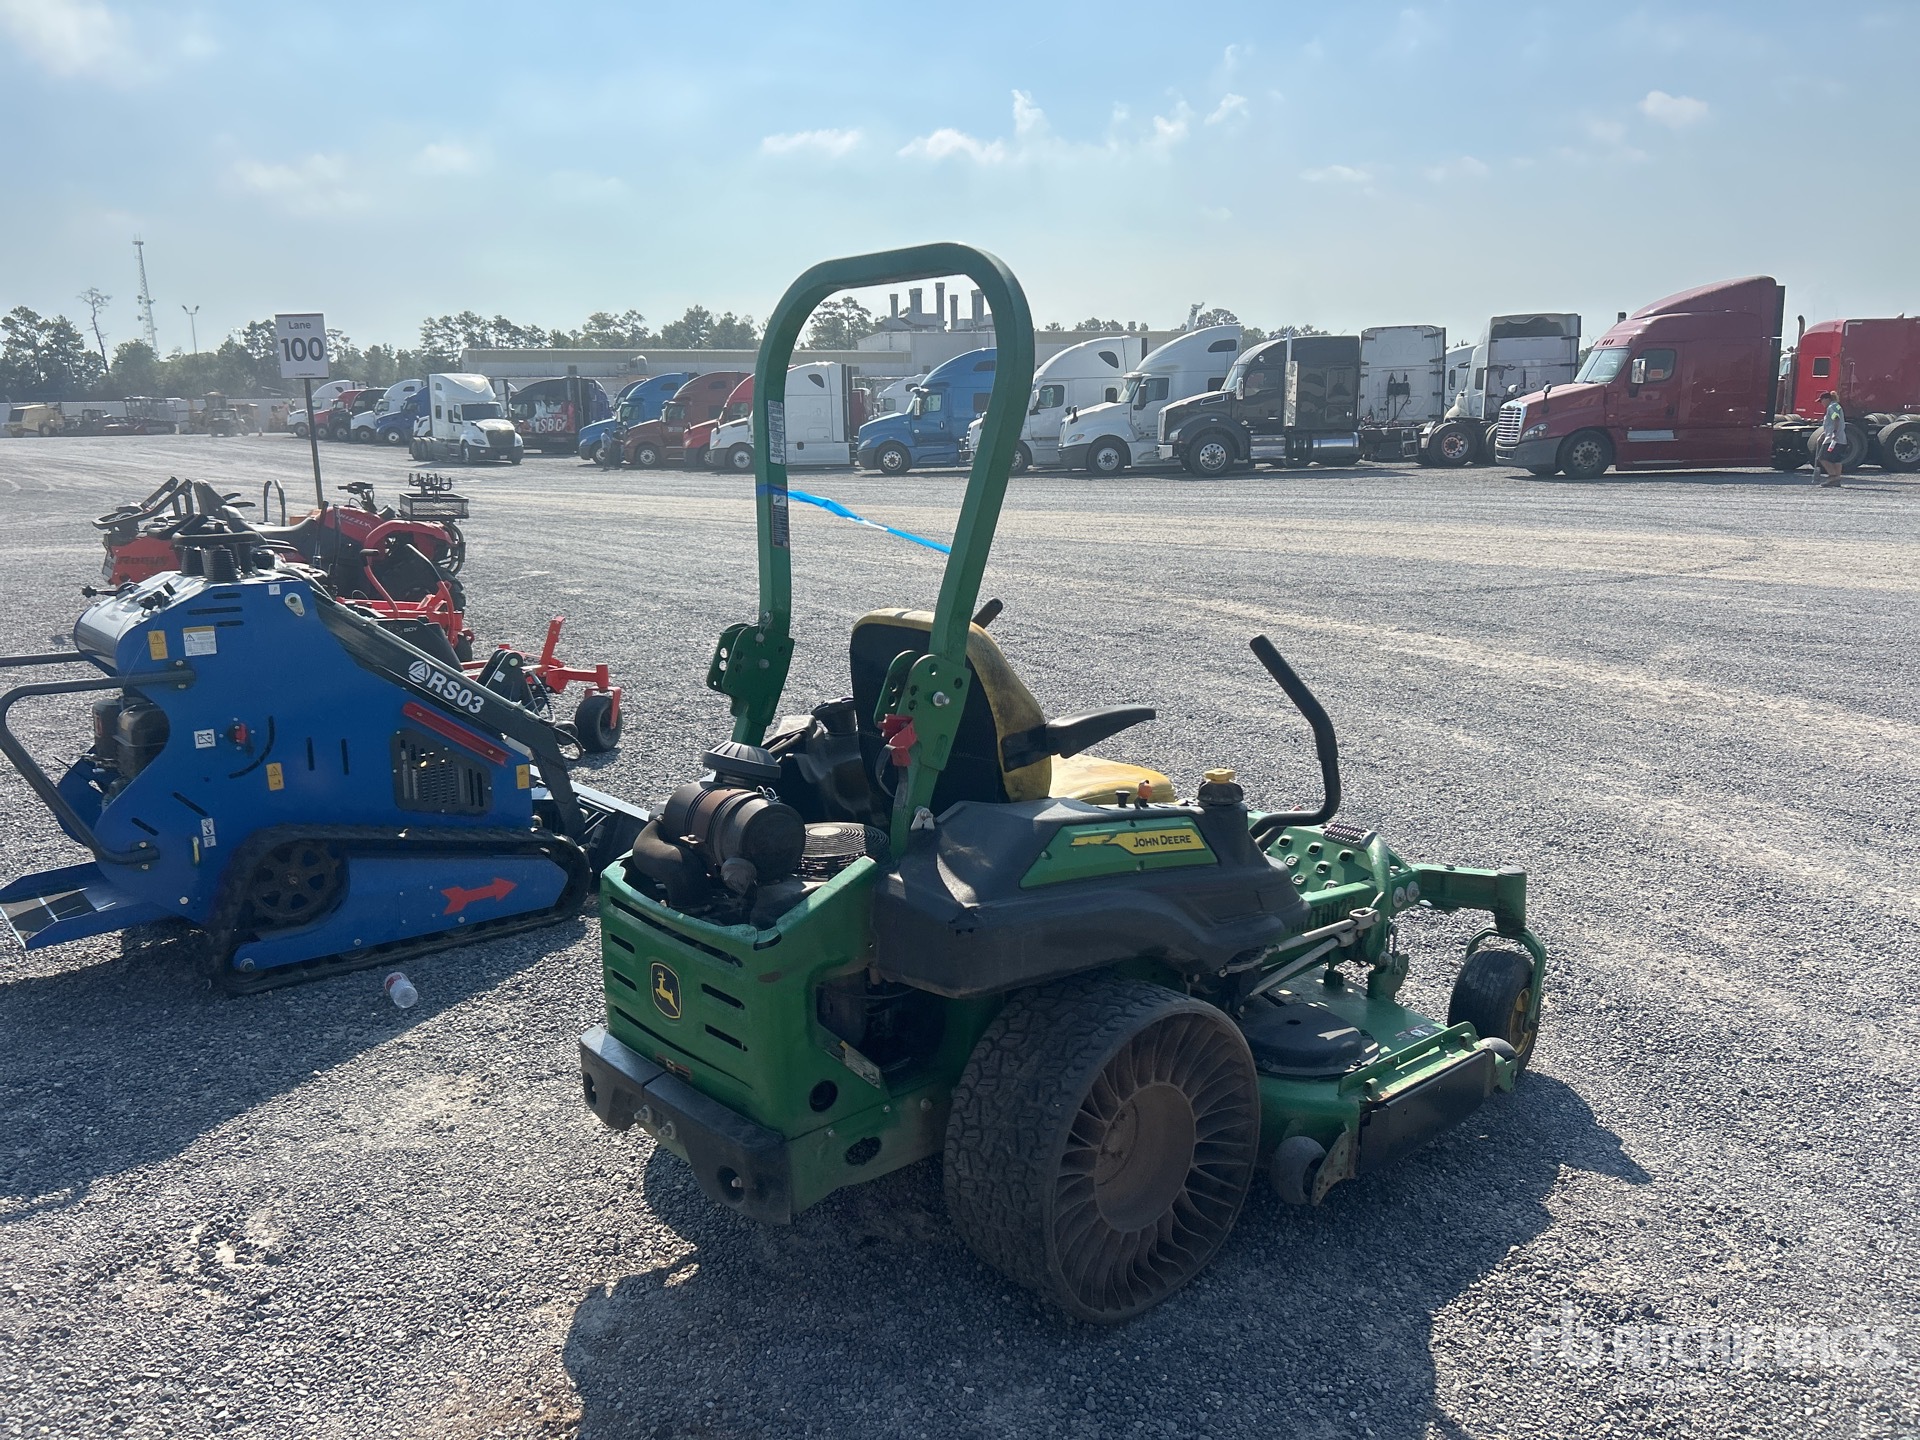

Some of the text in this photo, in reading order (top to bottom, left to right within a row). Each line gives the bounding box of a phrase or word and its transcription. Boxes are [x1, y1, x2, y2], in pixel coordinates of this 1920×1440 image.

[288, 321, 311, 329] Lane
[280, 337, 324, 362] 100
[540, 419, 562, 431] SBC
[427, 672, 485, 713] RS03
[1133, 835, 1191, 847] JOHN DEERE
